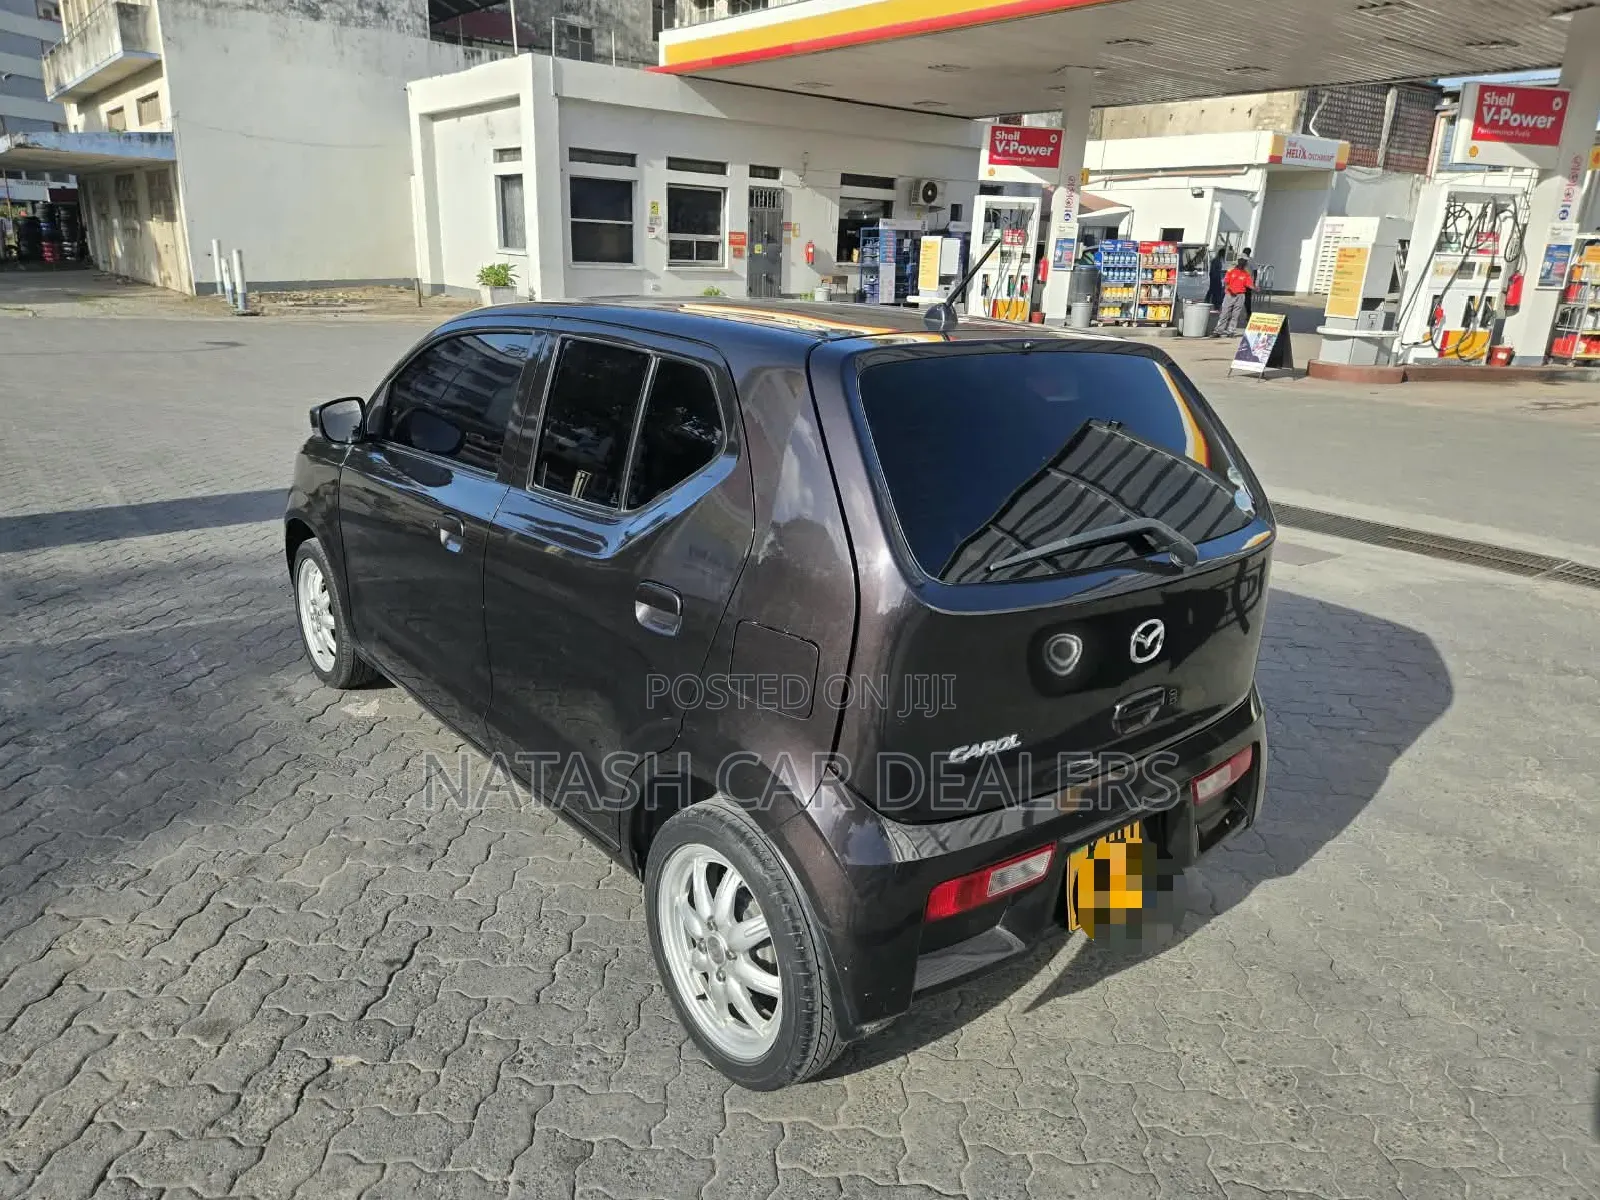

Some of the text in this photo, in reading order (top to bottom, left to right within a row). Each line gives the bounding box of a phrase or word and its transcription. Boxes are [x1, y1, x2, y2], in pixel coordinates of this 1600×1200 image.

[1483, 91, 1516, 107] Shell
[1482, 105, 1556, 130] V-Power
[995, 130, 1020, 141] Shell
[995, 140, 1054, 156] V-Power
[948, 733, 1022, 763] CAROL
